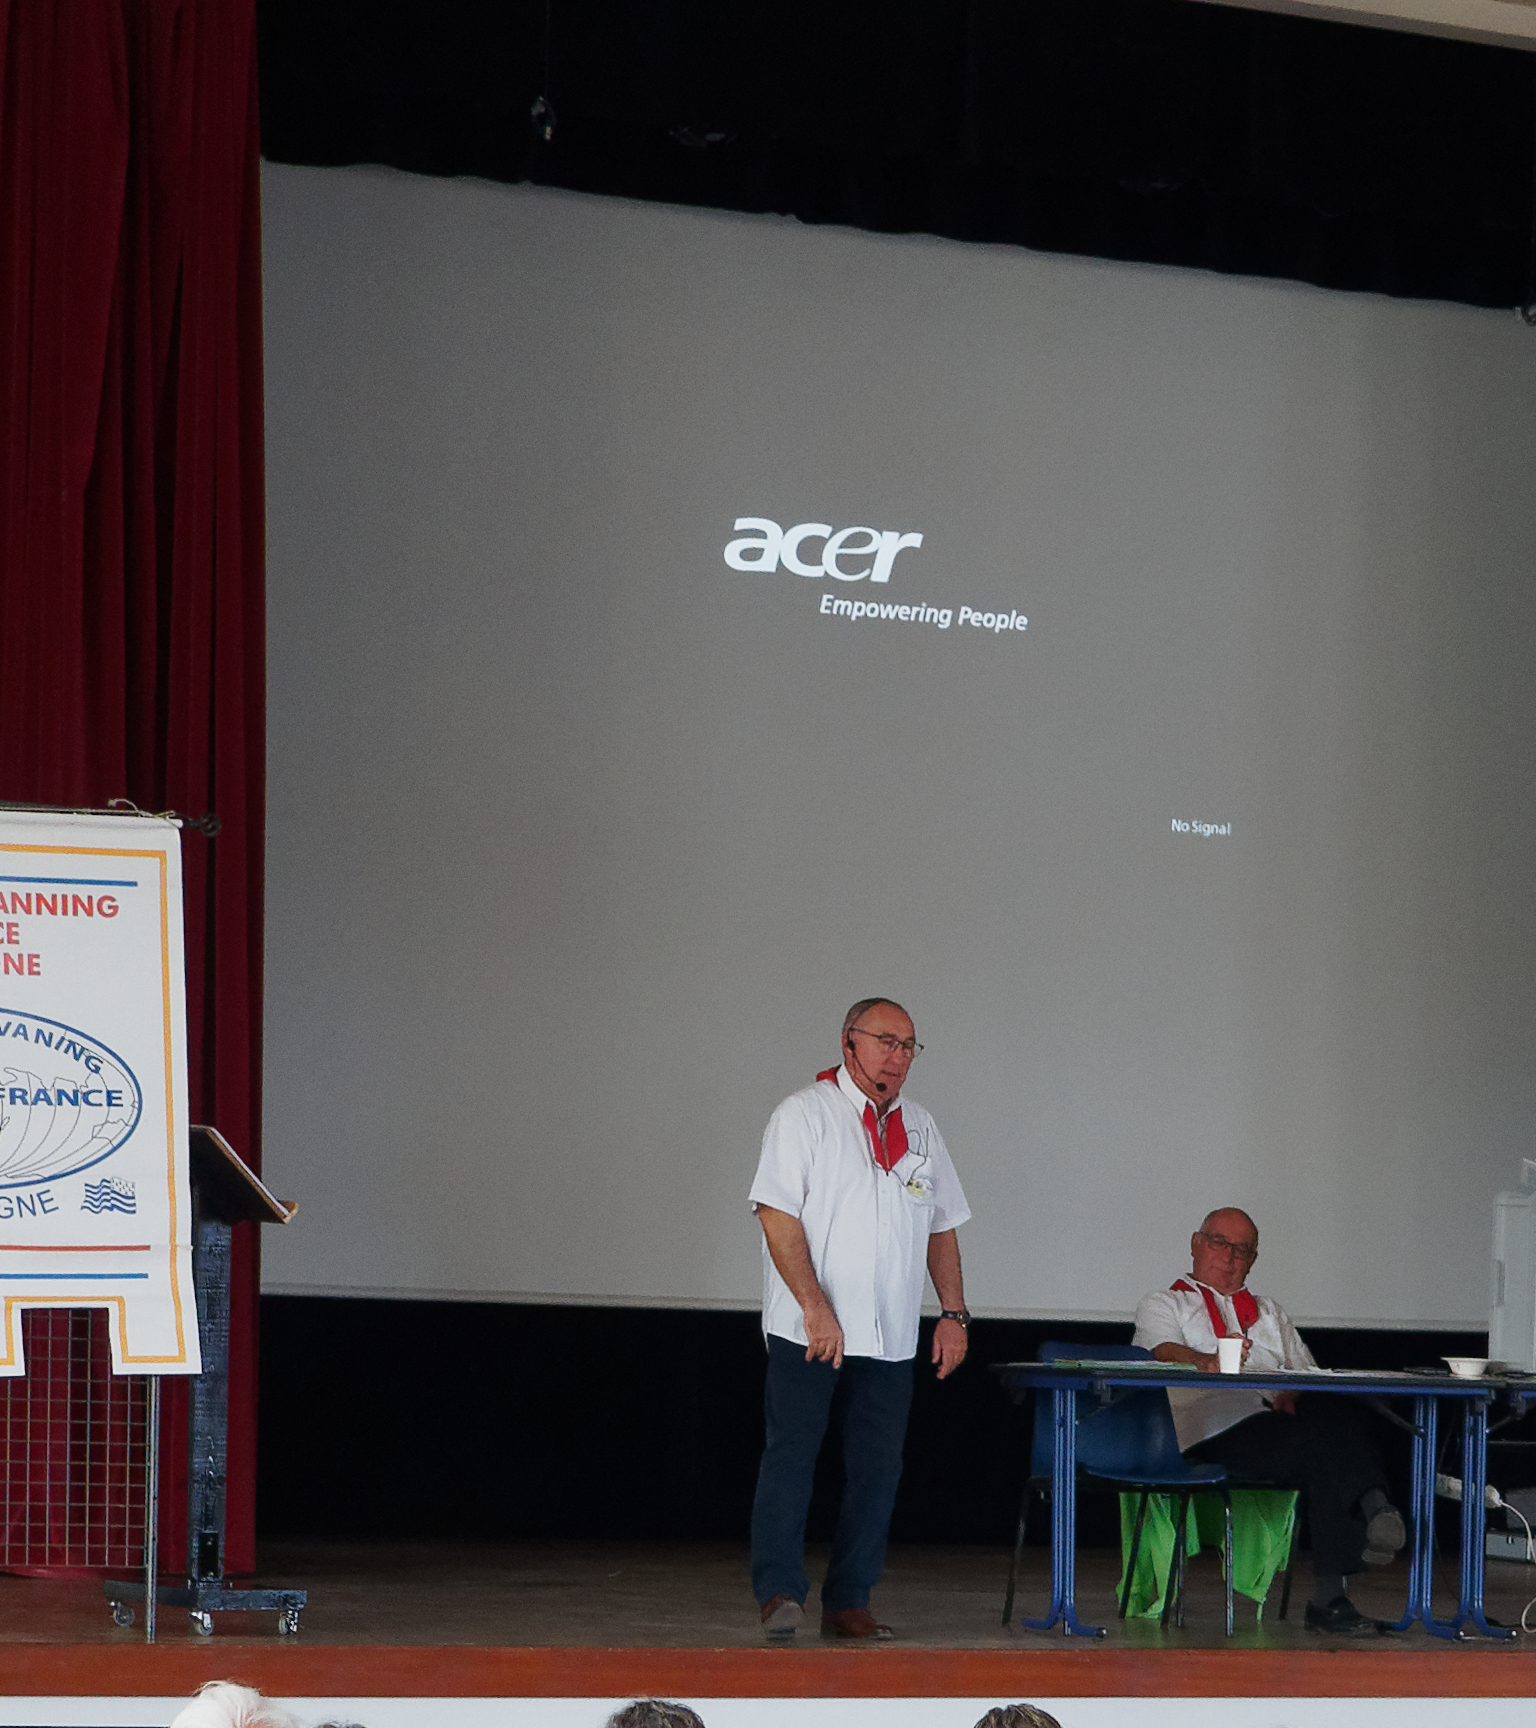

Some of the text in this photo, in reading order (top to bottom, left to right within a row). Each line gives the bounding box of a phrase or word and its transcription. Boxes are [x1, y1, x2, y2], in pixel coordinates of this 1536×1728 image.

[723, 517, 924, 583] acer
[819, 594, 1029, 633] Empowering People
[1171, 818, 1232, 837] No Signal
[3, 952, 41, 976] NE
[0, 1087, 124, 1107] RANCE
